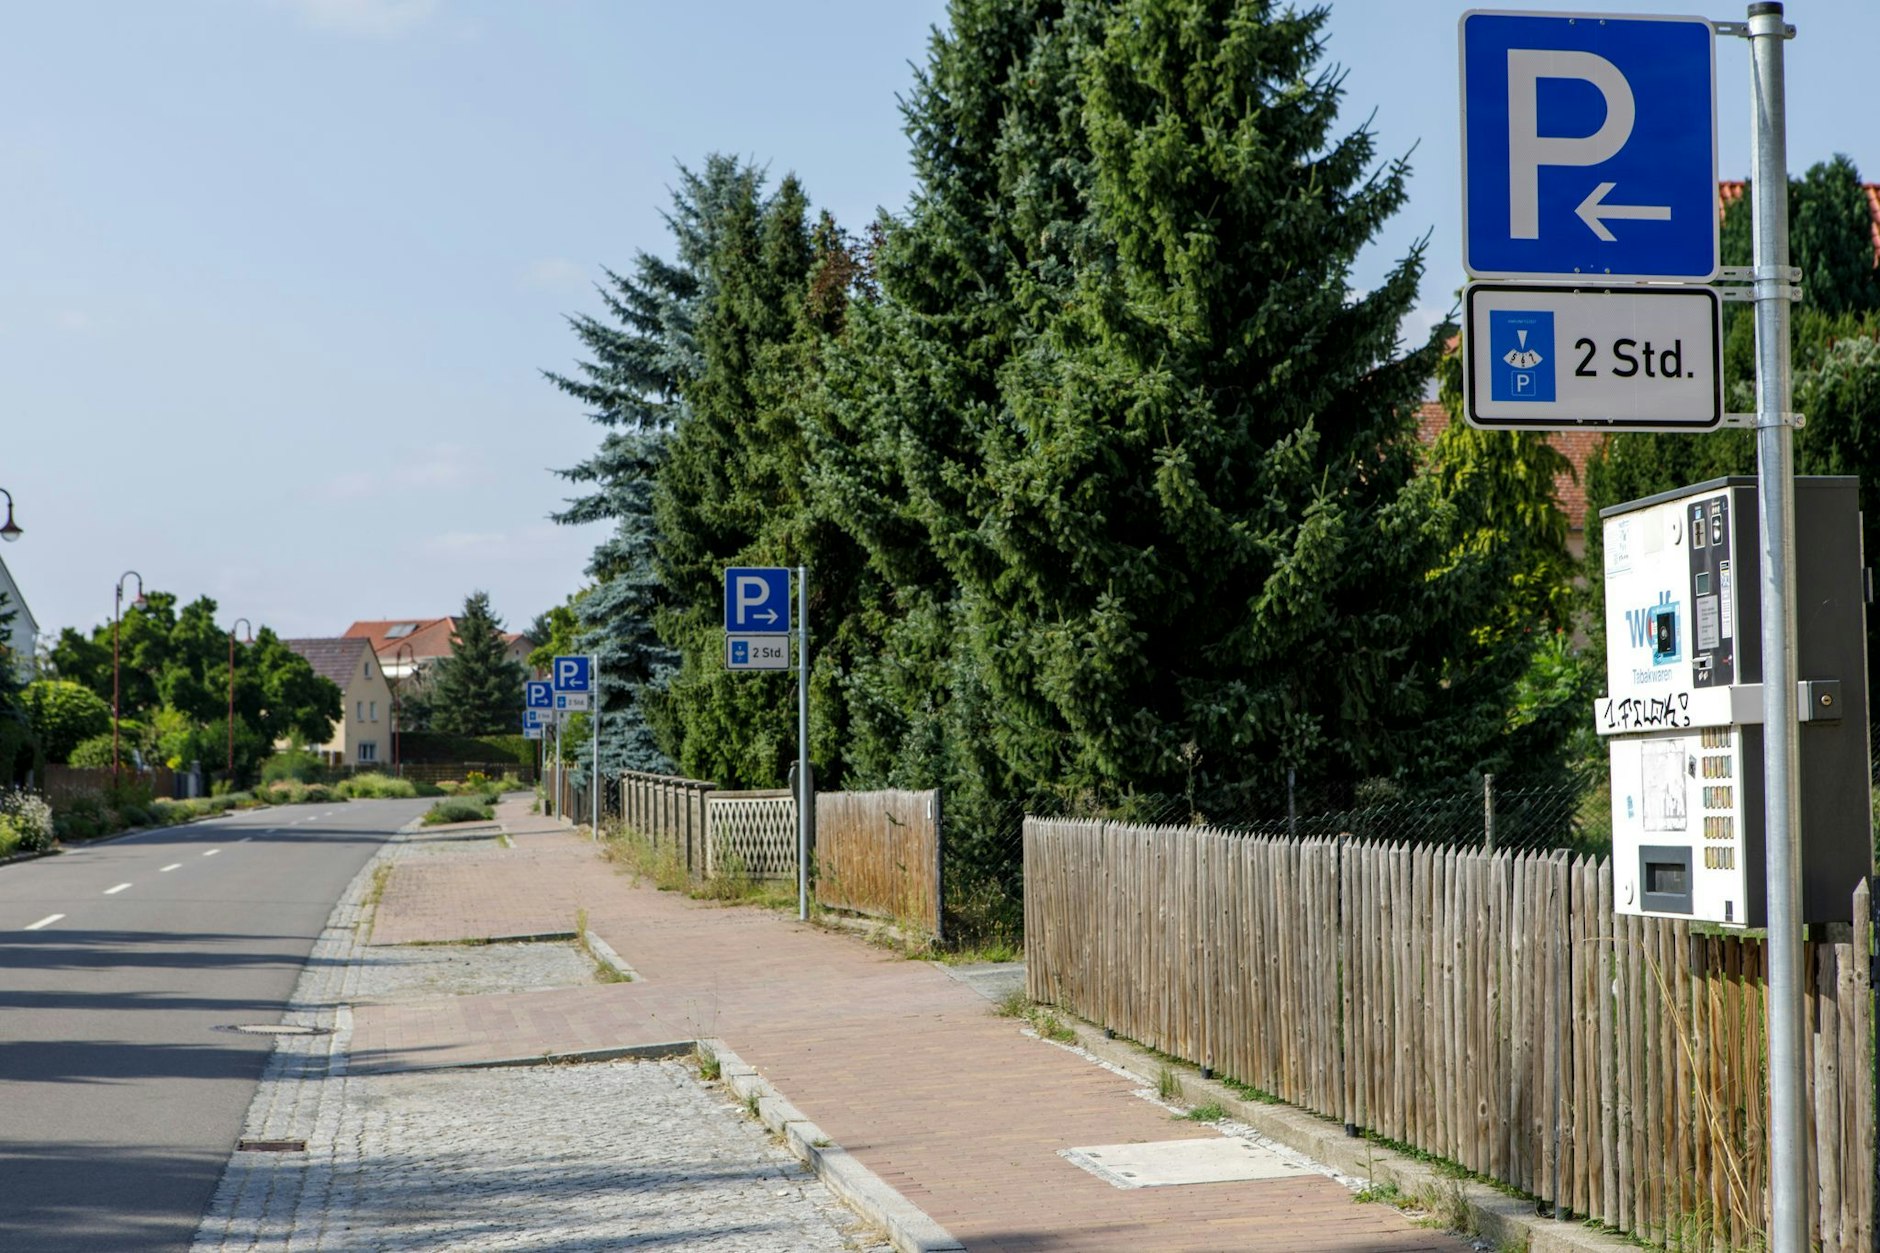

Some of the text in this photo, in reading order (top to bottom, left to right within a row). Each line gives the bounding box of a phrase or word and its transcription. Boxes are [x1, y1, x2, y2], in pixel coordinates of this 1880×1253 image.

[1507, 48, 1636, 240] P
[1575, 338, 1694, 378] 2 Std.
[1517, 374, 1530, 392] P
[736, 576, 770, 625] P
[752, 647, 784, 658] 2 Std.
[559, 660, 579, 688] P
[1632, 667, 1673, 685] Tabakwaren
[530, 684, 546, 706] P
